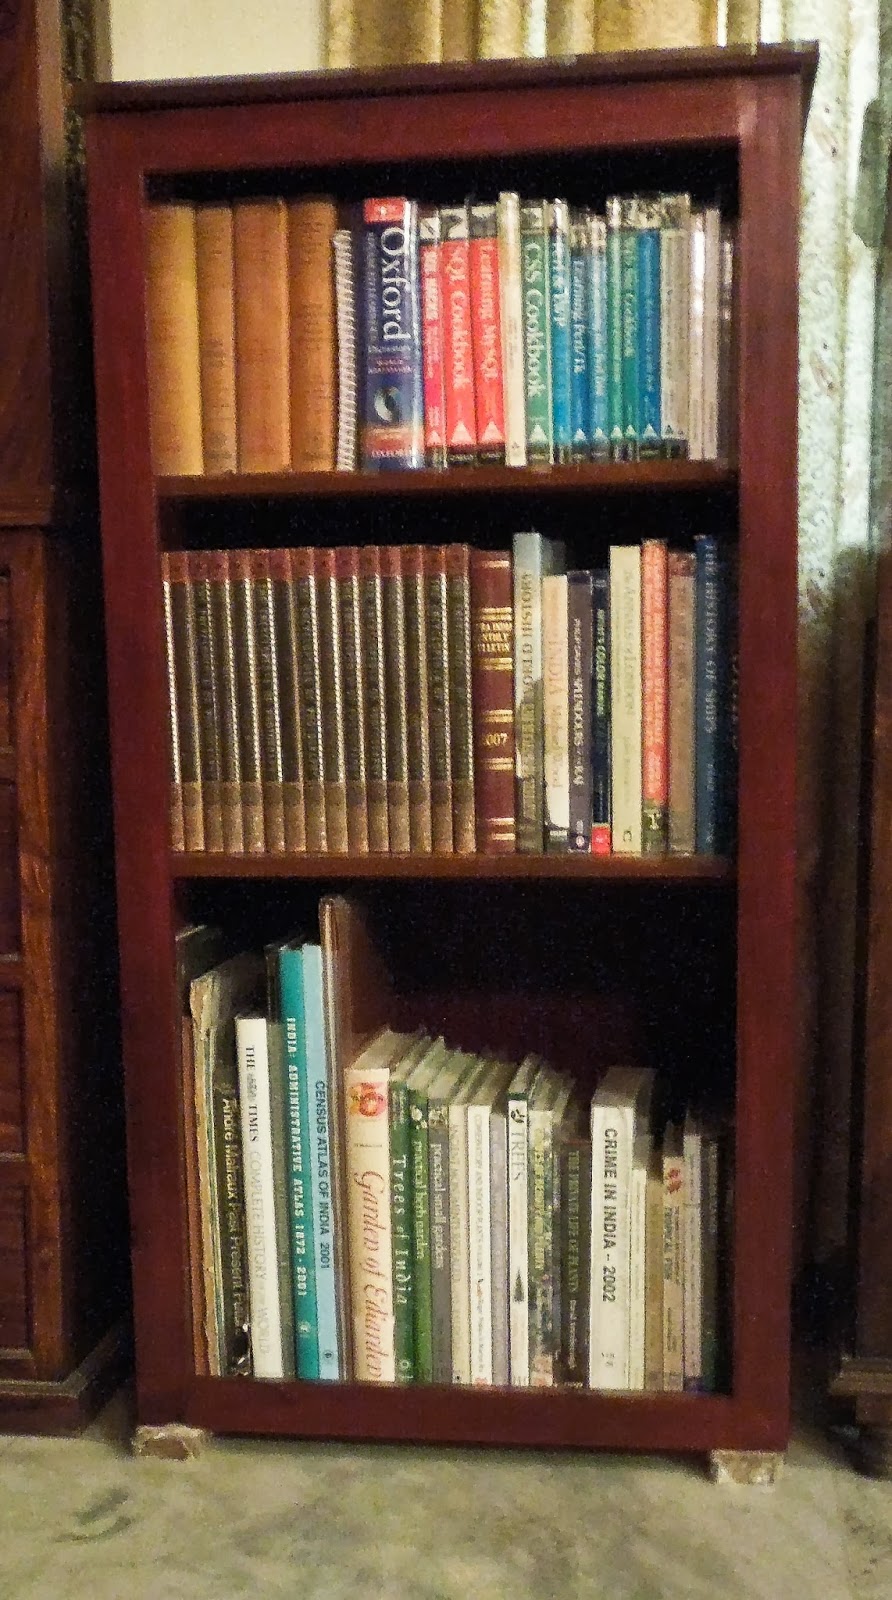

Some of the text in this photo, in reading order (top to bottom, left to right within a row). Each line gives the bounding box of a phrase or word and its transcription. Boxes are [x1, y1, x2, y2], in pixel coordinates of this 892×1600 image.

[381, 227, 411, 341] Oxford
[446, 247, 469, 390] SQL Cookbook
[479, 245, 499, 379] Learning MySQL
[524, 242, 546, 398] CSS Cookbook
[521, 571, 534, 637] HISTORY
[521, 642, 534, 694] WORLD
[548, 640, 564, 696] INDIA
[595, 645, 606, 680] COLOR
[245, 1045, 257, 1070] THE
[247, 1104, 259, 1142] TIMES
[288, 1065, 303, 1172] ADMINISTRATIVE
[224, 1144, 240, 1200] Malraux
[315, 1081, 331, 1270] CENSUS ATLAS OF INDIA 2001
[411, 1141, 426, 1188] practical
[510, 1130, 526, 1181] TREES
[603, 1128, 618, 1178] CRIME
[250, 1151, 264, 1221] COMPLETE
[294, 1178, 305, 1217] ATLAS
[353, 1170, 387, 1251] Garden
[431, 1143, 447, 1269] practical small gardens
[604, 1184, 617, 1200] IN
[253, 1225, 268, 1280] HISTORY
[295, 1224, 306, 1254] 1872
[392, 1154, 412, 1305] Trees of India
[603, 1206, 617, 1249] INDIA
[296, 1266, 307, 1296] 2001
[360, 1256, 388, 1277] of
[602, 1266, 617, 1302] 2002
